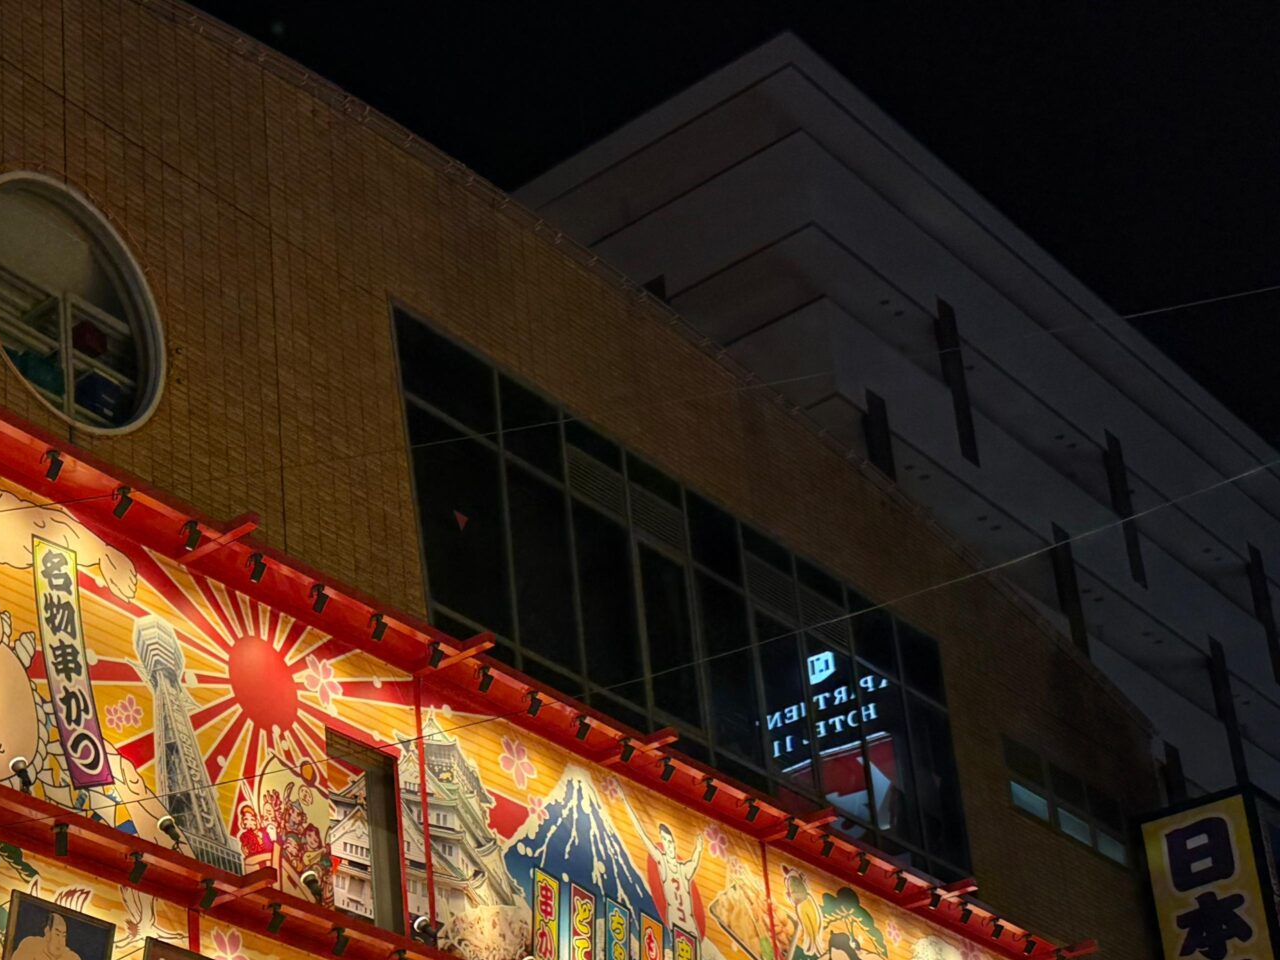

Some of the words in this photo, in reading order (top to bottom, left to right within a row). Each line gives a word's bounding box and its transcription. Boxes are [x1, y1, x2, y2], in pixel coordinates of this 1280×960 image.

[40, 549, 104, 775] 名物串かつ
